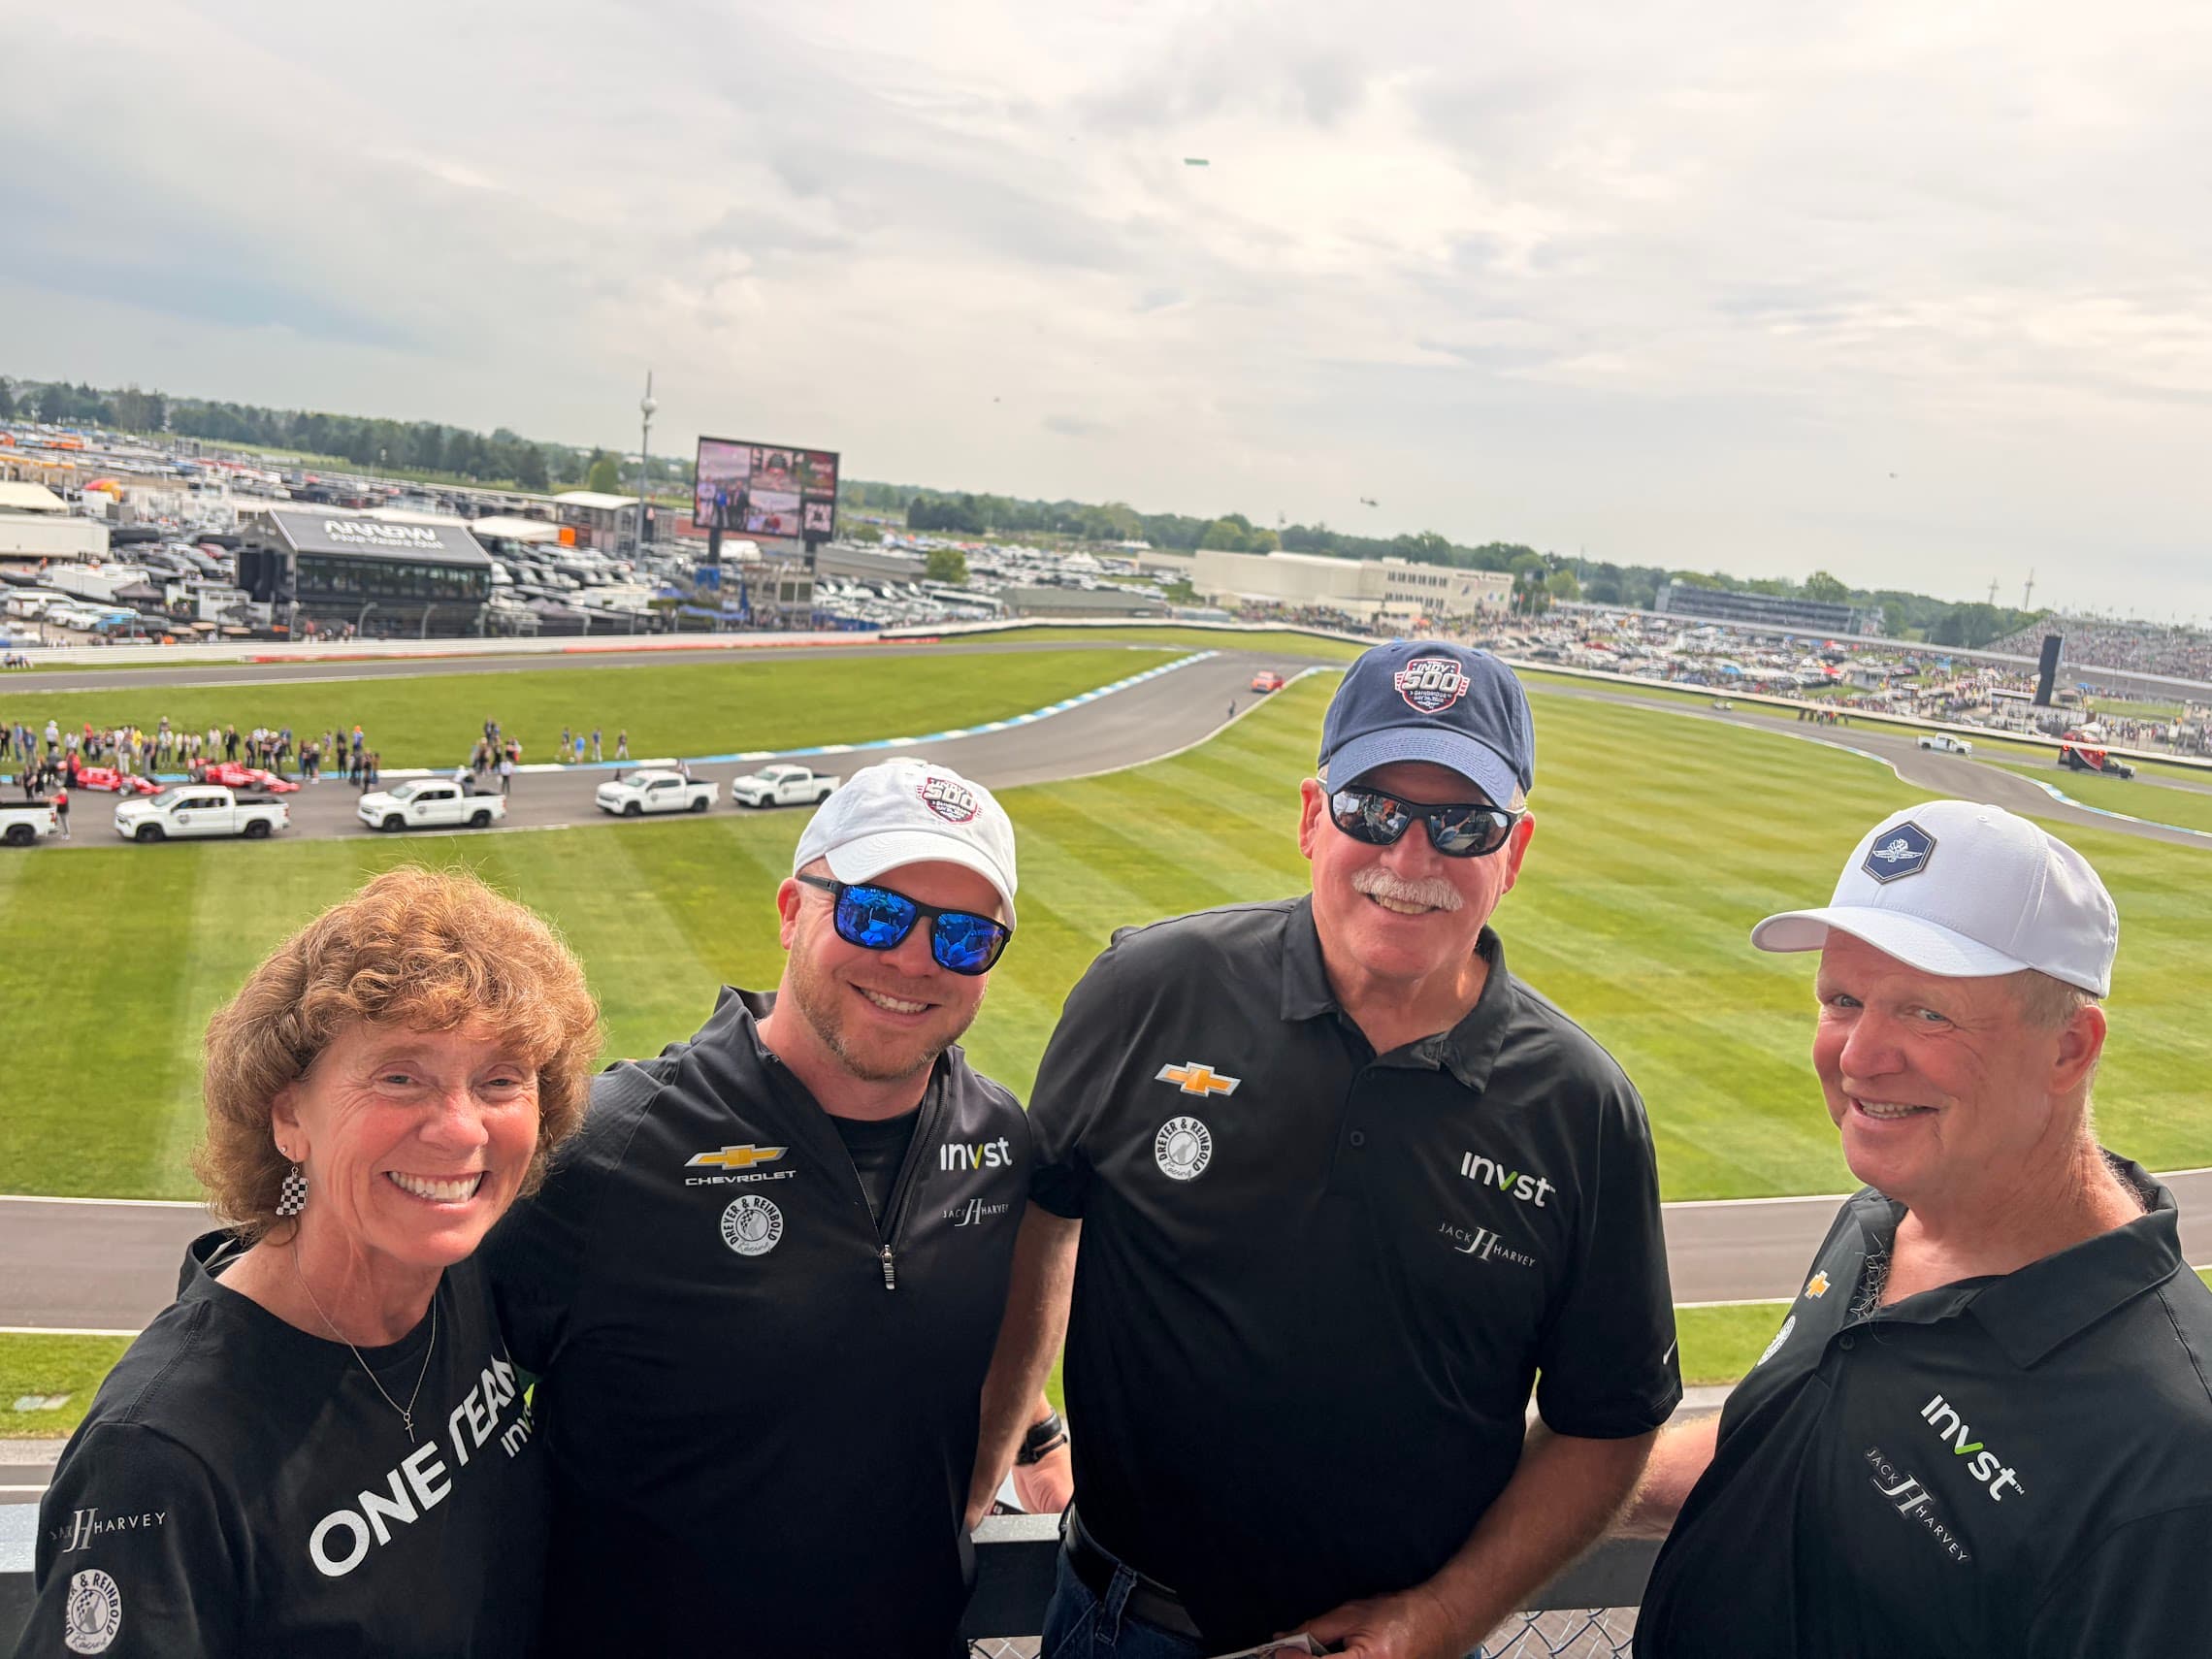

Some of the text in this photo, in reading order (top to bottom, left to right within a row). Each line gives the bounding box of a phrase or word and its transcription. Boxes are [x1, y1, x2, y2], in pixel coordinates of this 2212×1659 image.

[1401, 670, 1461, 693] 500
[1416, 663, 1450, 673] INDY
[923, 783, 977, 813] 500
[940, 1136, 1013, 1171] invst
[1157, 1118, 1210, 1172] DREYER & REINBOLD
[685, 1170, 797, 1186] CHEVROLET
[1460, 1151, 1551, 1207] invst
[724, 1197, 781, 1245] DREYER & REINBOLD
[981, 1204, 1010, 1216] HARVEY
[1439, 1222, 1473, 1243] JACK
[1493, 1244, 1537, 1268] HARVEY
[1920, 1394, 2016, 1502] invst
[94, 1512, 166, 1535] HARVEY
[309, 1440, 452, 1578] ONE
[1867, 1449, 1900, 1484] JACK
[1915, 1505, 1968, 1562] HARVEY
[80, 1573, 118, 1636] & REINBOLD
